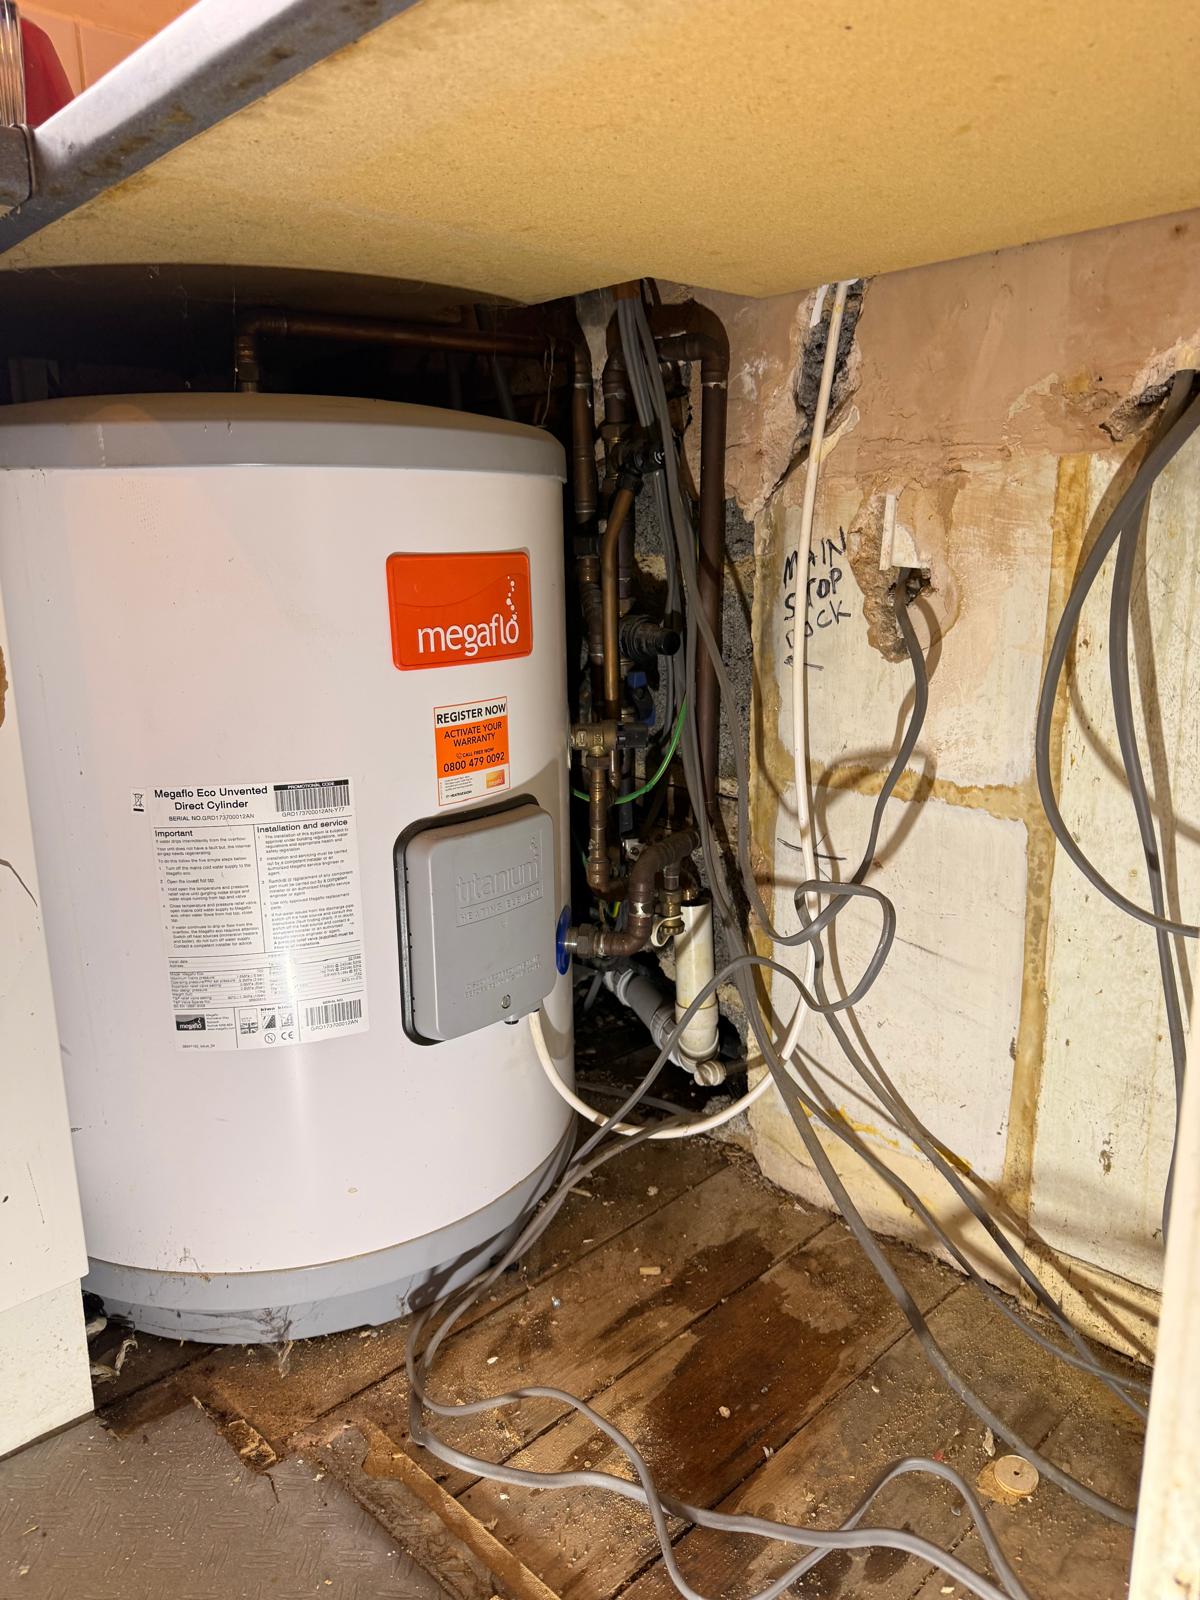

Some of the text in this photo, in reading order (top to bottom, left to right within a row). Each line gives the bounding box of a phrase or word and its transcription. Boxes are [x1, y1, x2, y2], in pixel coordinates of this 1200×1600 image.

[418, 614, 519, 656] megaflo
[436, 704, 506, 724] REGISTER NOW
[444, 722, 502, 739] ACTIVATE YOUR
[453, 733, 495, 747] WARRANTY
[444, 752, 505, 772] 0800 479 0092
[154, 789, 194, 799] Megaflo
[219, 787, 268, 796] Unvented
[175, 800, 248, 810] Direct Cylinder
[155, 830, 193, 838] Important
[257, 824, 300, 833] Installation
[456, 862, 539, 902] titanium
